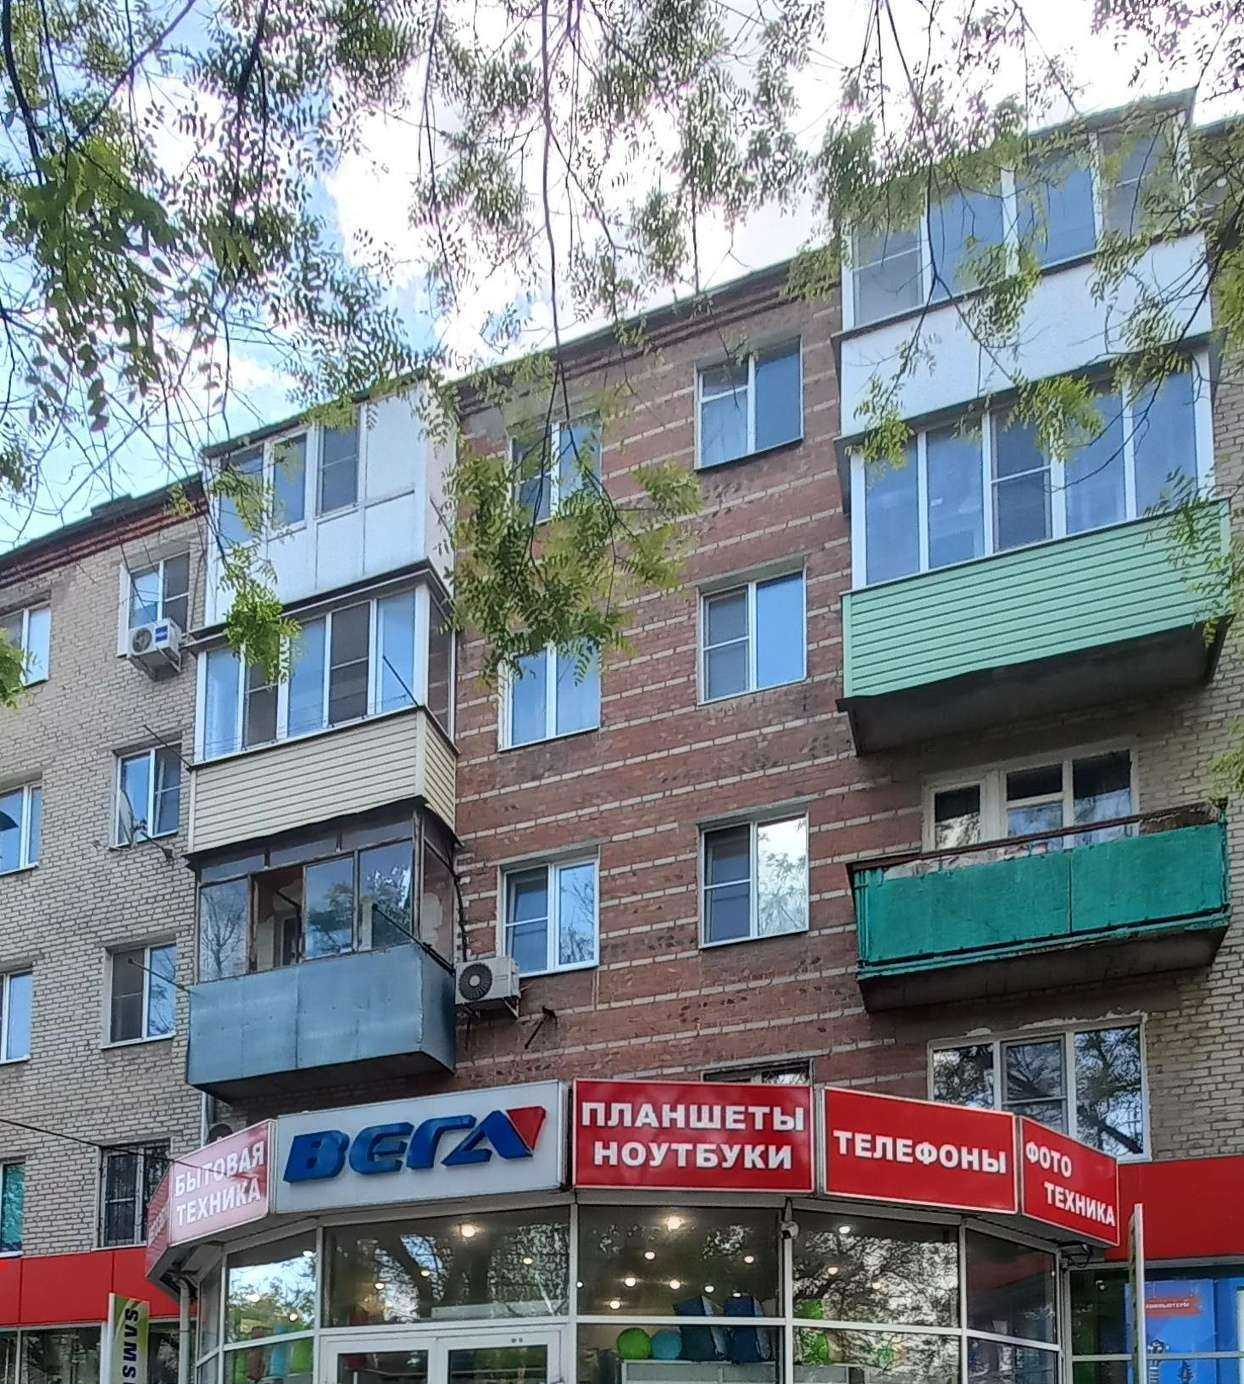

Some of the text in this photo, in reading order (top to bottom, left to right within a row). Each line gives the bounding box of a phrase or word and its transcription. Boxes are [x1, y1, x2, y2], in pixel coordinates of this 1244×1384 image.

[582, 1102, 804, 1131] ПЛАНШЕТЫ
[175, 1141, 264, 1197] БЫТОВАЯ
[283, 1110, 533, 1183] ВЕГА
[594, 1141, 792, 1170] НОУТБУКИ
[833, 1130, 1006, 1174] ТЕЛЕФОНЫ
[1025, 1141, 1072, 1178] ФОТО
[176, 1178, 261, 1226] ТЕХНИКА
[1044, 1181, 1116, 1227] ТЕХНИКА
